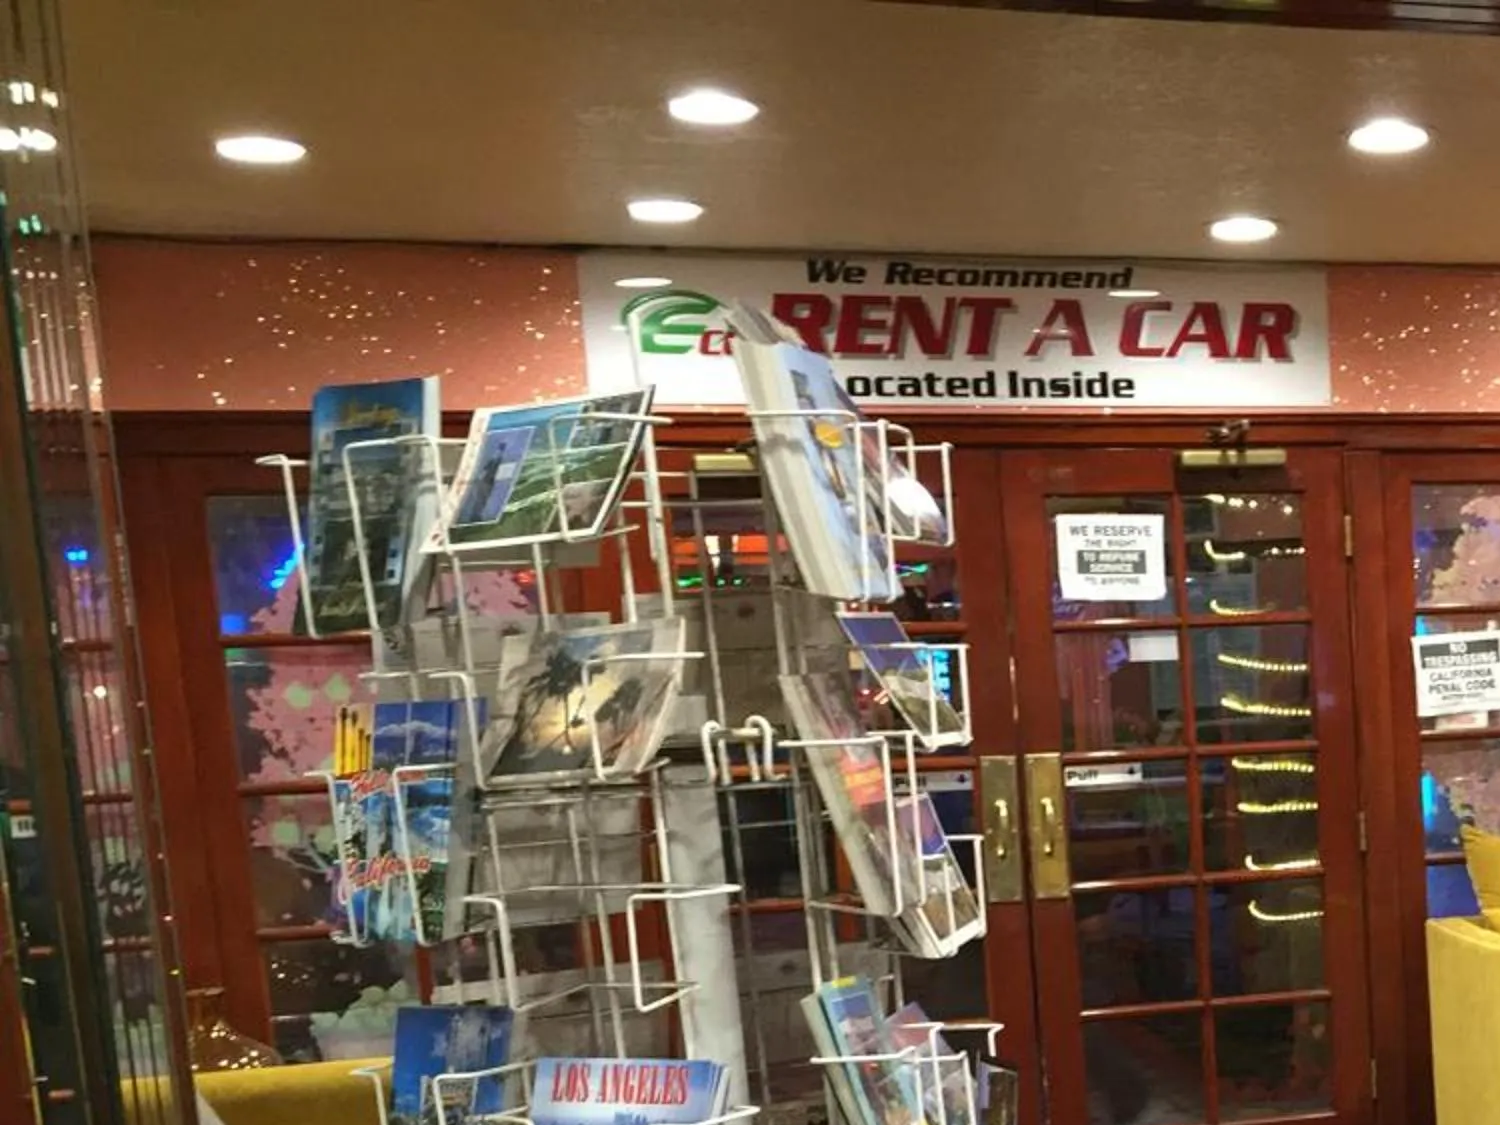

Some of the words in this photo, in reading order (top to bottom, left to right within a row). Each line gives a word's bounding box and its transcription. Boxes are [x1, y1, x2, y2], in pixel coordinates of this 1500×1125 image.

[806, 258, 866, 285] We
[883, 261, 1134, 291] Recommend
[771, 292, 1013, 357] RENT
[1026, 299, 1094, 358] A
[1117, 301, 1296, 360] CAR
[846, 371, 997, 400] ocated
[1007, 371, 1135, 400] Inside
[1069, 525, 1089, 537] WE
[1093, 525, 1153, 537] RESERVE
[1449, 641, 1468, 653] NO
[1423, 651, 1497, 669] TRESPASSING
[1429, 668, 1493, 683] CALIFORNIA
[1428, 683, 1462, 695] PENAL
[1466, 679, 1496, 691] CODE
[551, 1061, 590, 1104] LOS
[596, 1063, 690, 1106] ANGELES
